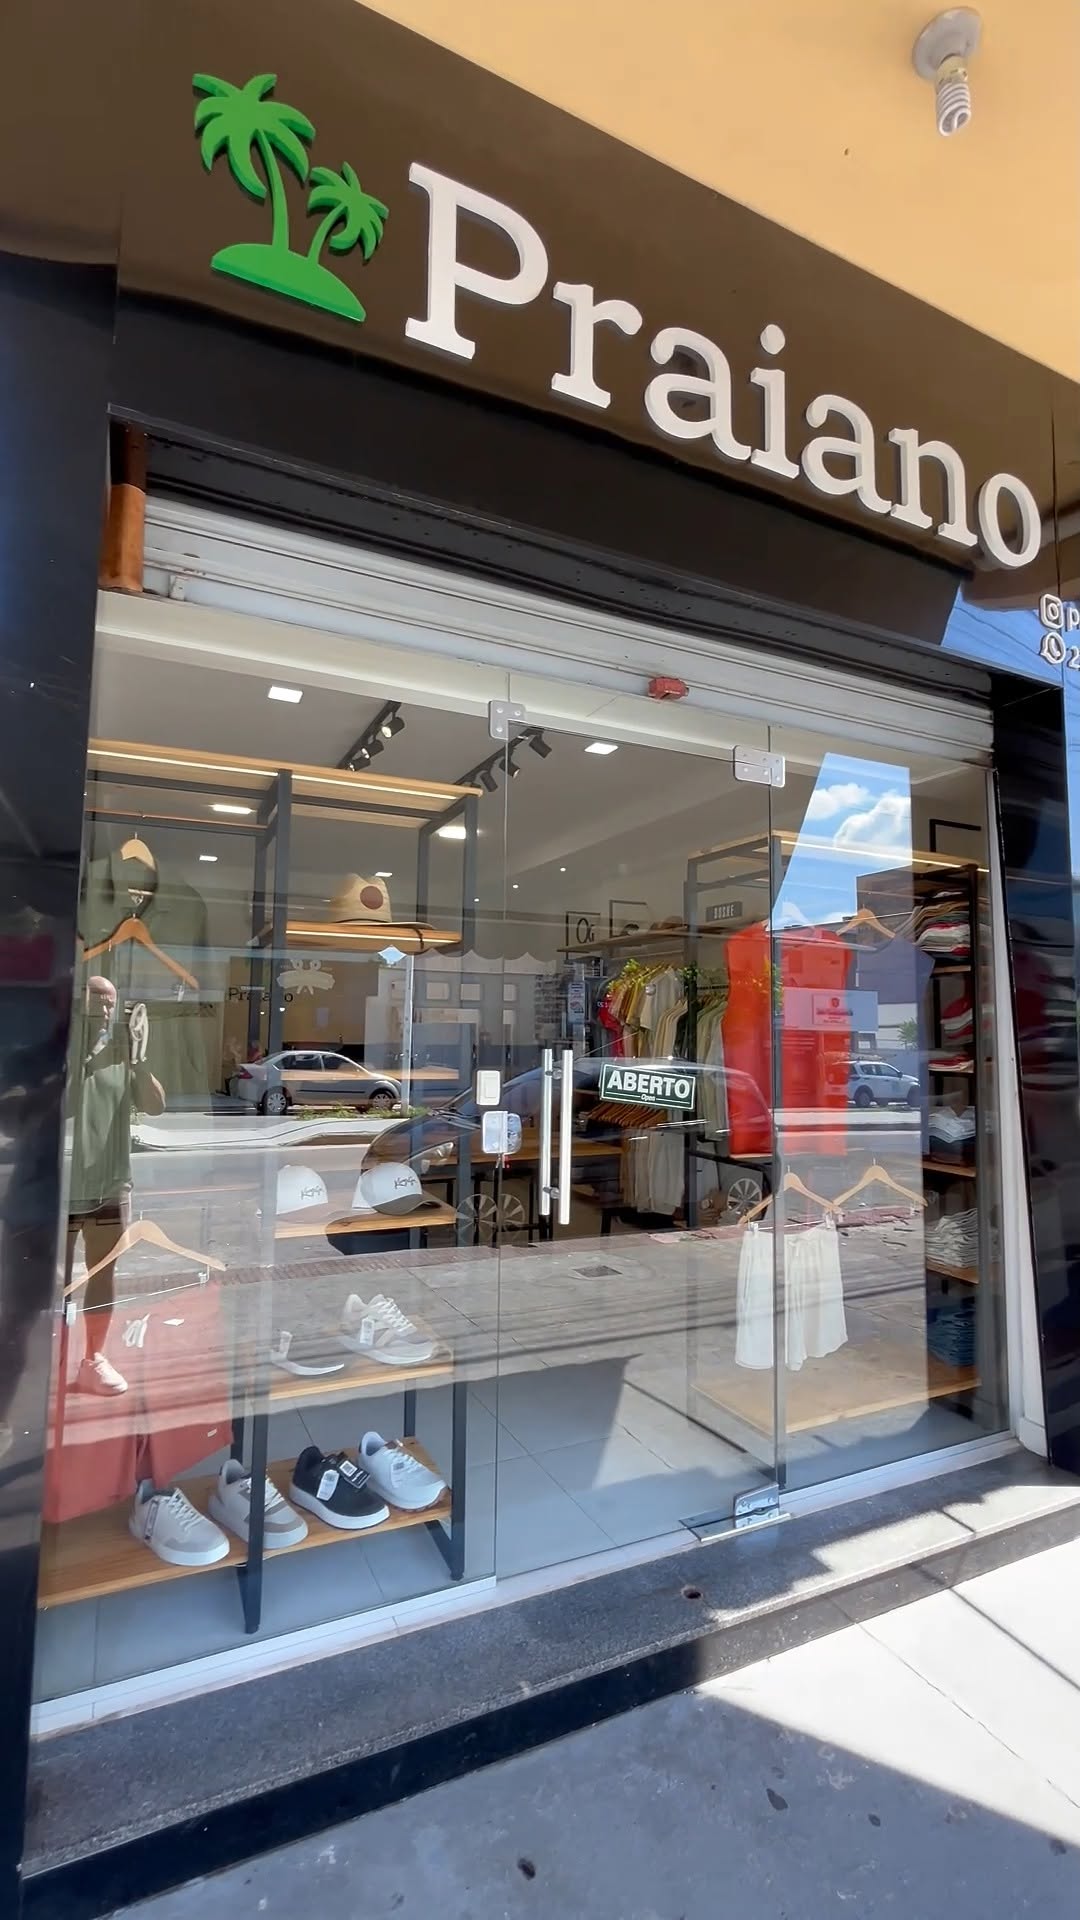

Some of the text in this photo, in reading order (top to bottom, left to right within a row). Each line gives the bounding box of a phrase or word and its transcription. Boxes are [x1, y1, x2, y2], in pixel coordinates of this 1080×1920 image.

[404, 161, 1042, 568] Praiano
[606, 1070, 690, 1098] ABERTO
[640, 1093, 656, 1101] Open
